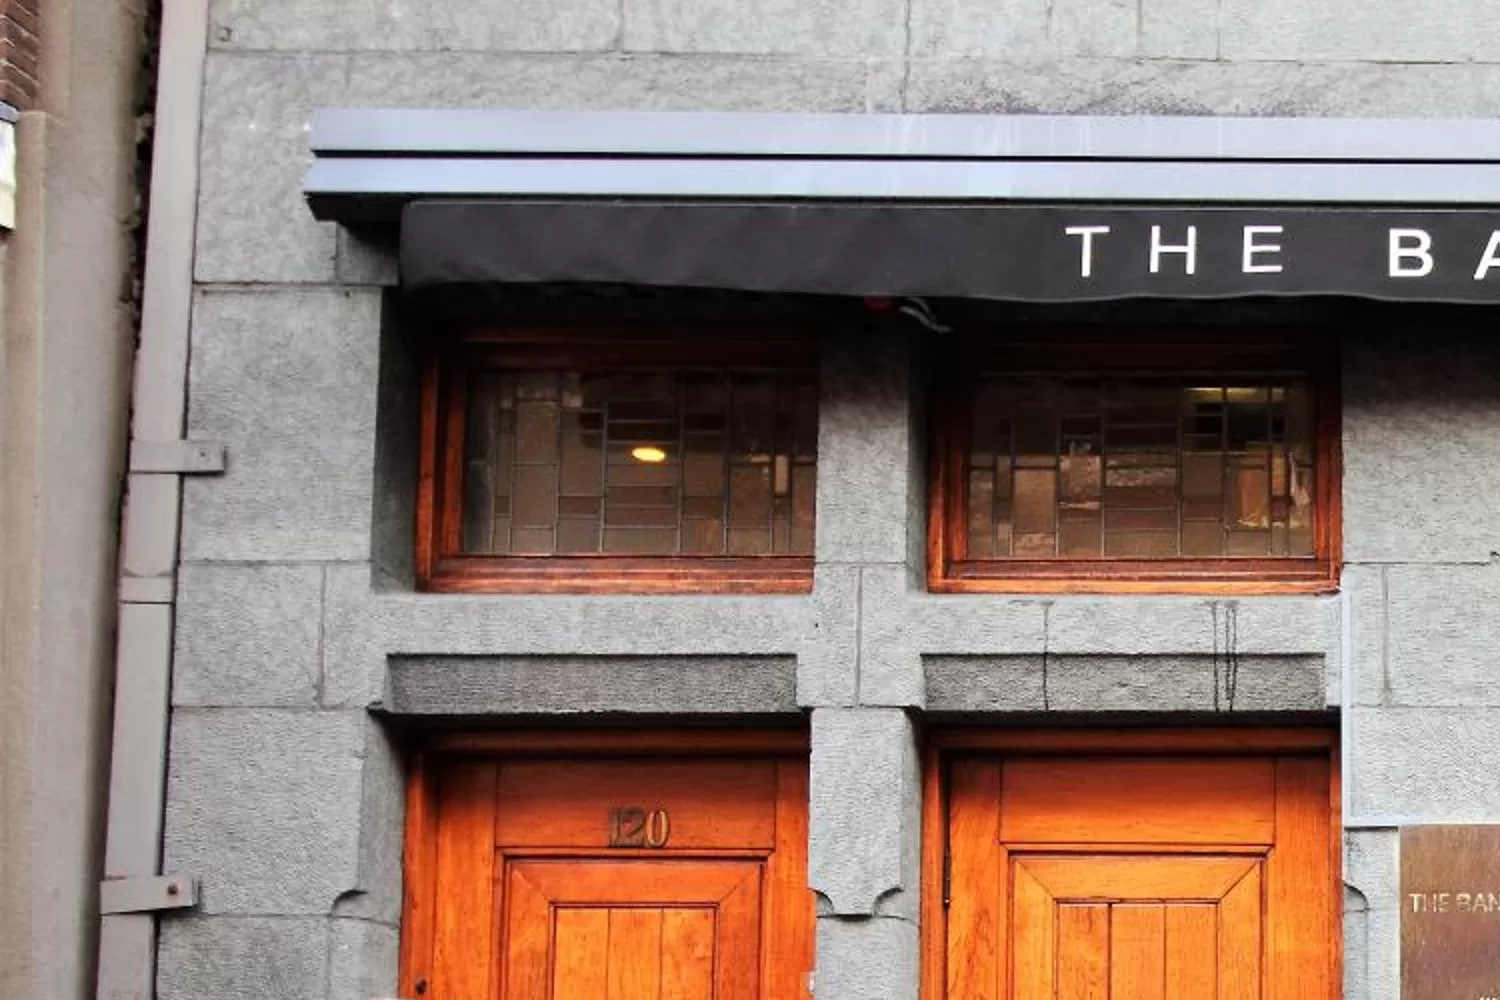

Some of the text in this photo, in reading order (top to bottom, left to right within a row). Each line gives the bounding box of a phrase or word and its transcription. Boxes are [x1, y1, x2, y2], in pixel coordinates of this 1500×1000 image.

[1065, 224, 1284, 278] THE
[609, 807, 670, 848] 120
[1408, 893, 1450, 913] THE
